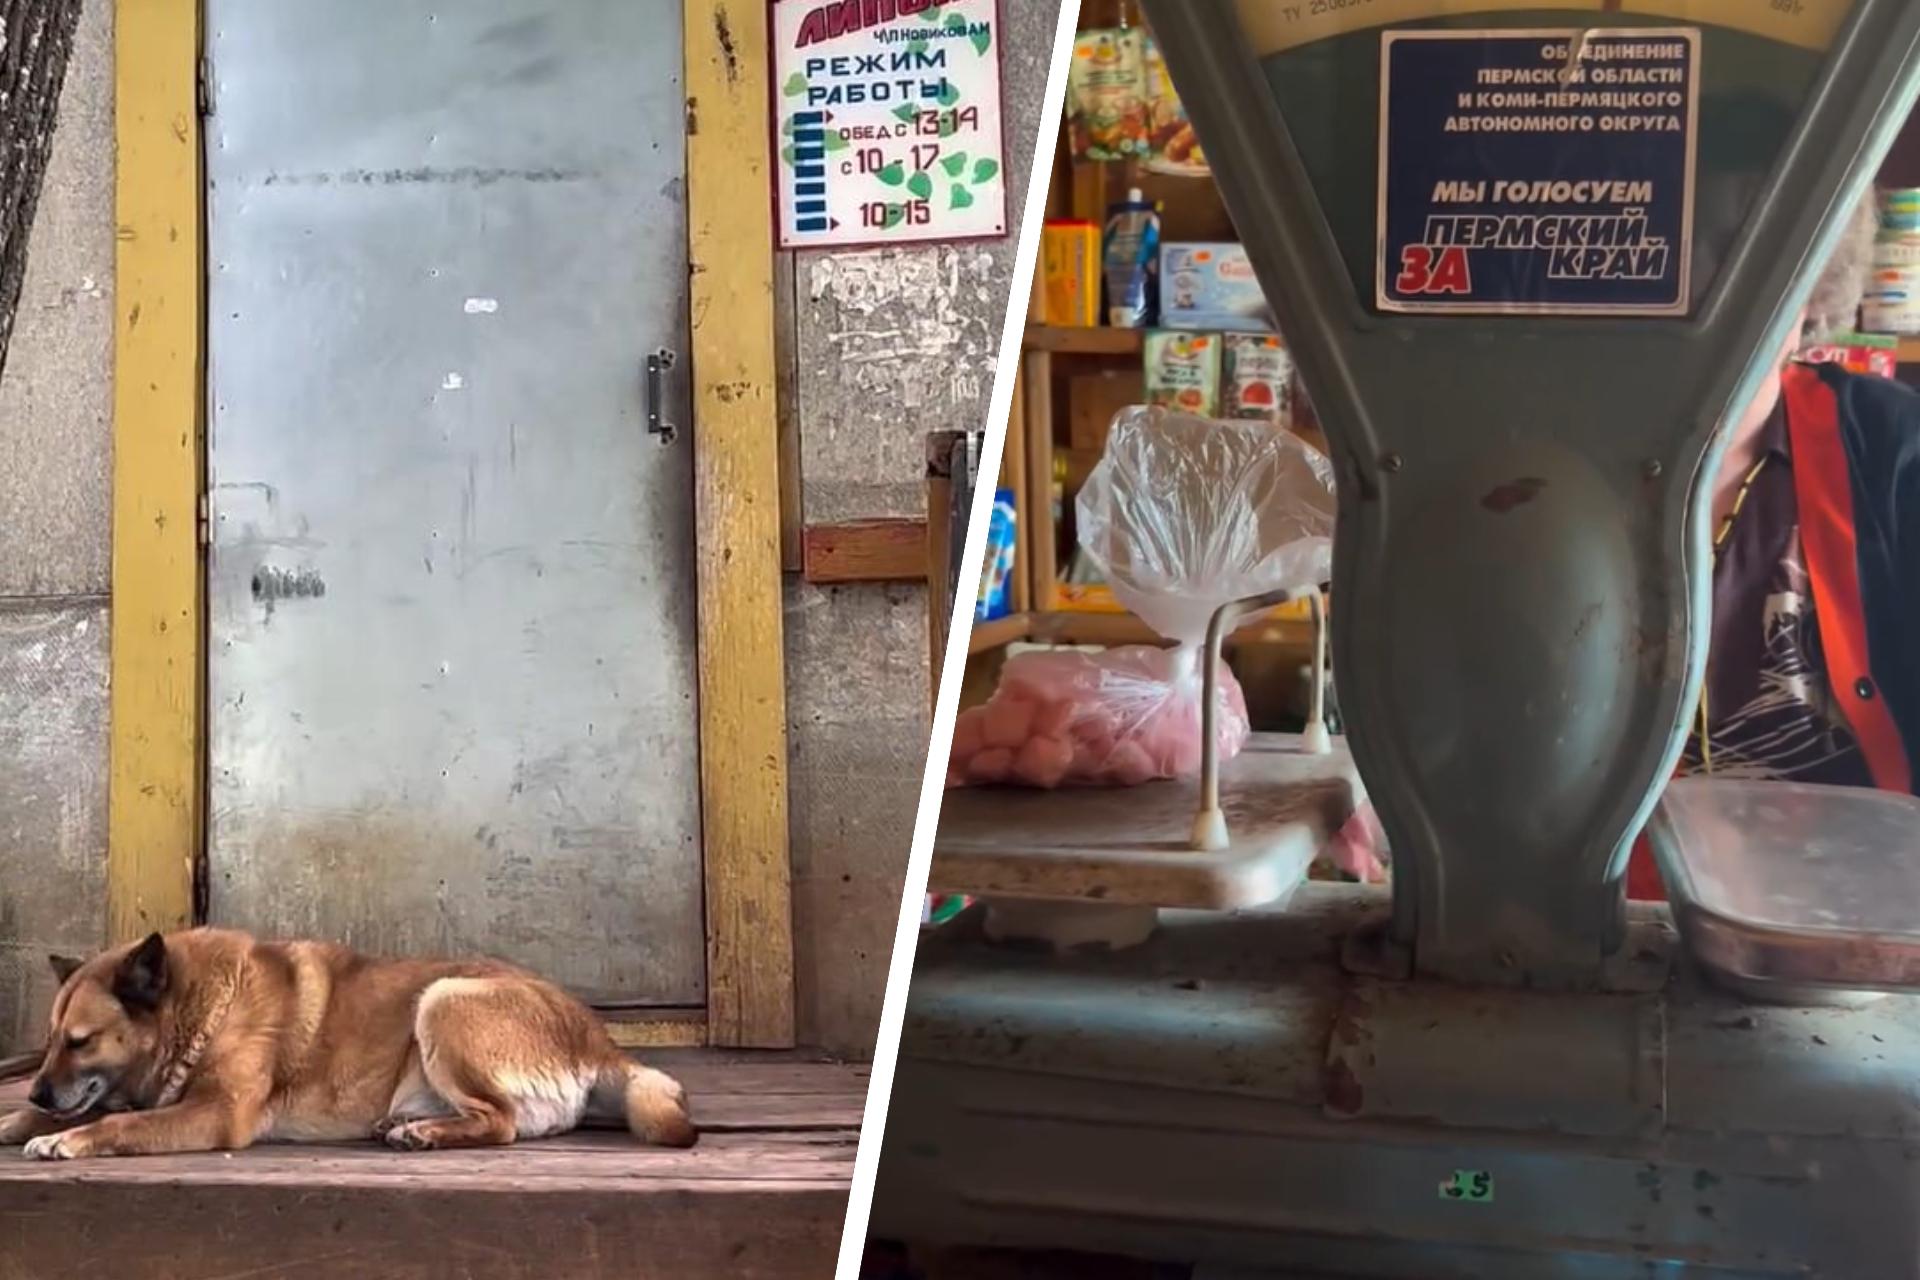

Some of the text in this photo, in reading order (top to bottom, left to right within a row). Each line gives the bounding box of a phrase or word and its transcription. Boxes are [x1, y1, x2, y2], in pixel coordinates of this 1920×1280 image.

[806, 49, 946, 78] РЕЖИМ
[1541, 43, 1684, 61] ОБЕДИНЕНИЕ
[1590, 67, 1683, 83] ОБЛАСТИ
[808, 77, 948, 106] РАБОТЫ
[1458, 91, 1682, 110] И КОМИ-ПЕРМЯЦКОГО
[839, 126, 892, 141] ОБЕД
[912, 106, 979, 136] 13-14
[1444, 115, 1681, 132] АВТОНОМНОГО ОКРУГА
[1431, 180, 1653, 203] МЫ ГОЛОСУЕМ
[859, 200, 931, 228] 10-15
[1422, 207, 1648, 249] ПЕРМСКИЙ
[1396, 237, 1669, 294] ЗА КРАЙ
